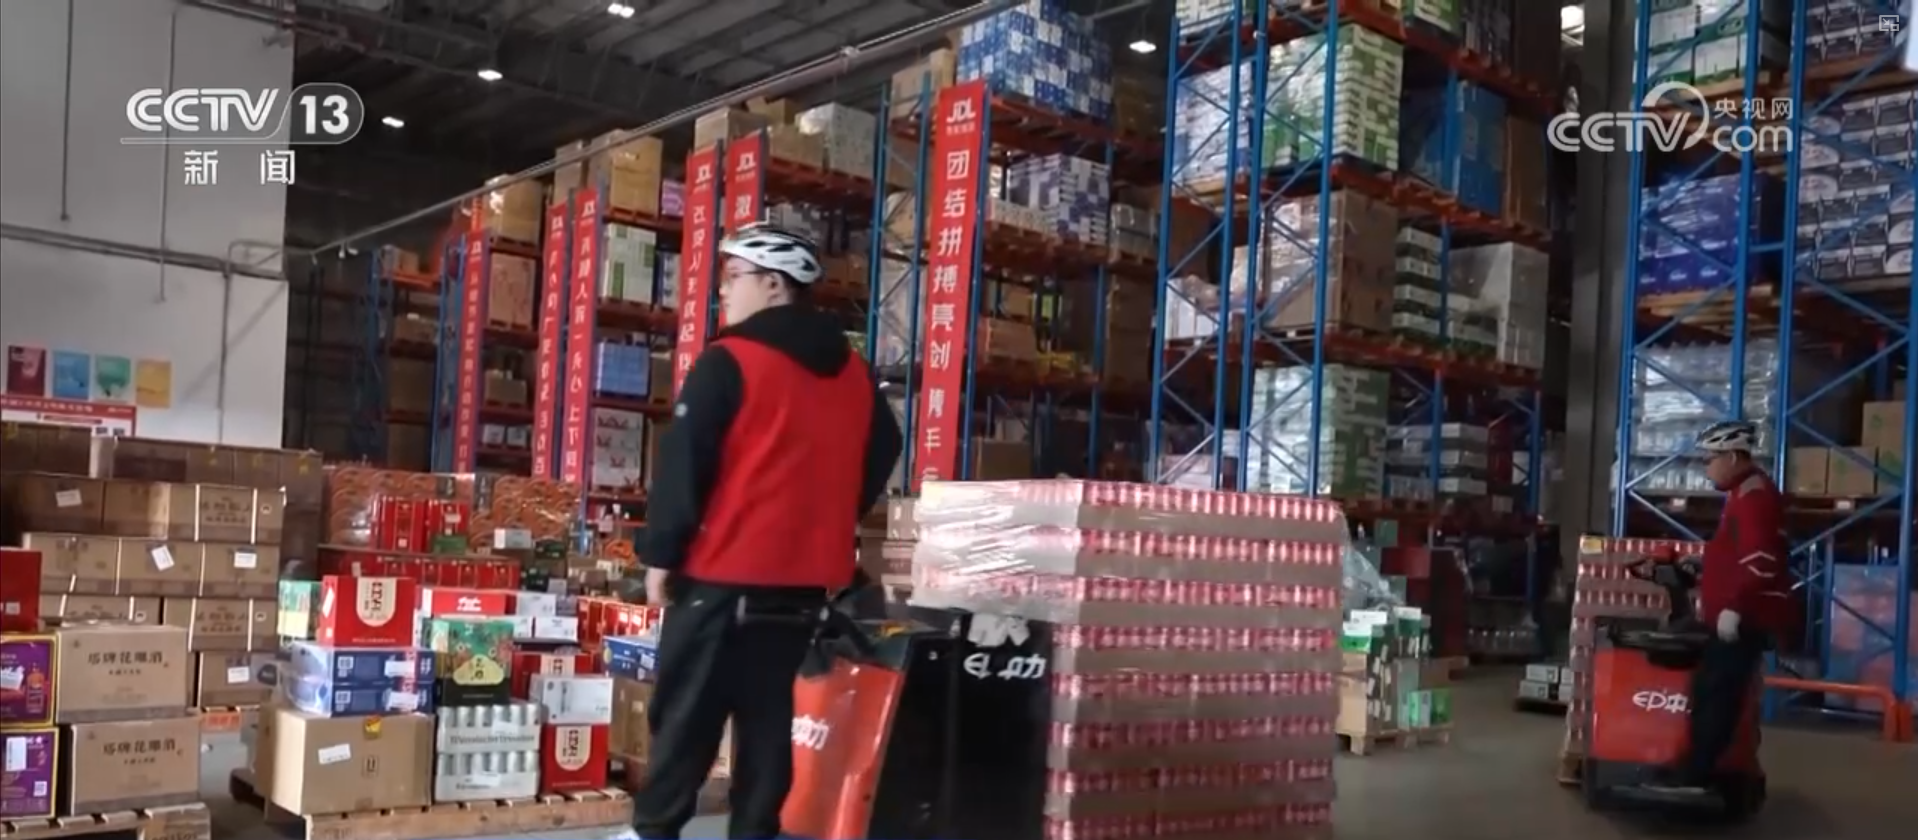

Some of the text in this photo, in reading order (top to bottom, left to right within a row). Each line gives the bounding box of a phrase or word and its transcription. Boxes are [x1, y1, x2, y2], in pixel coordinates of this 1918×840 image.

[946, 98, 976, 123] JDL
[930, 149, 970, 372] 团结拼搏亮剑
